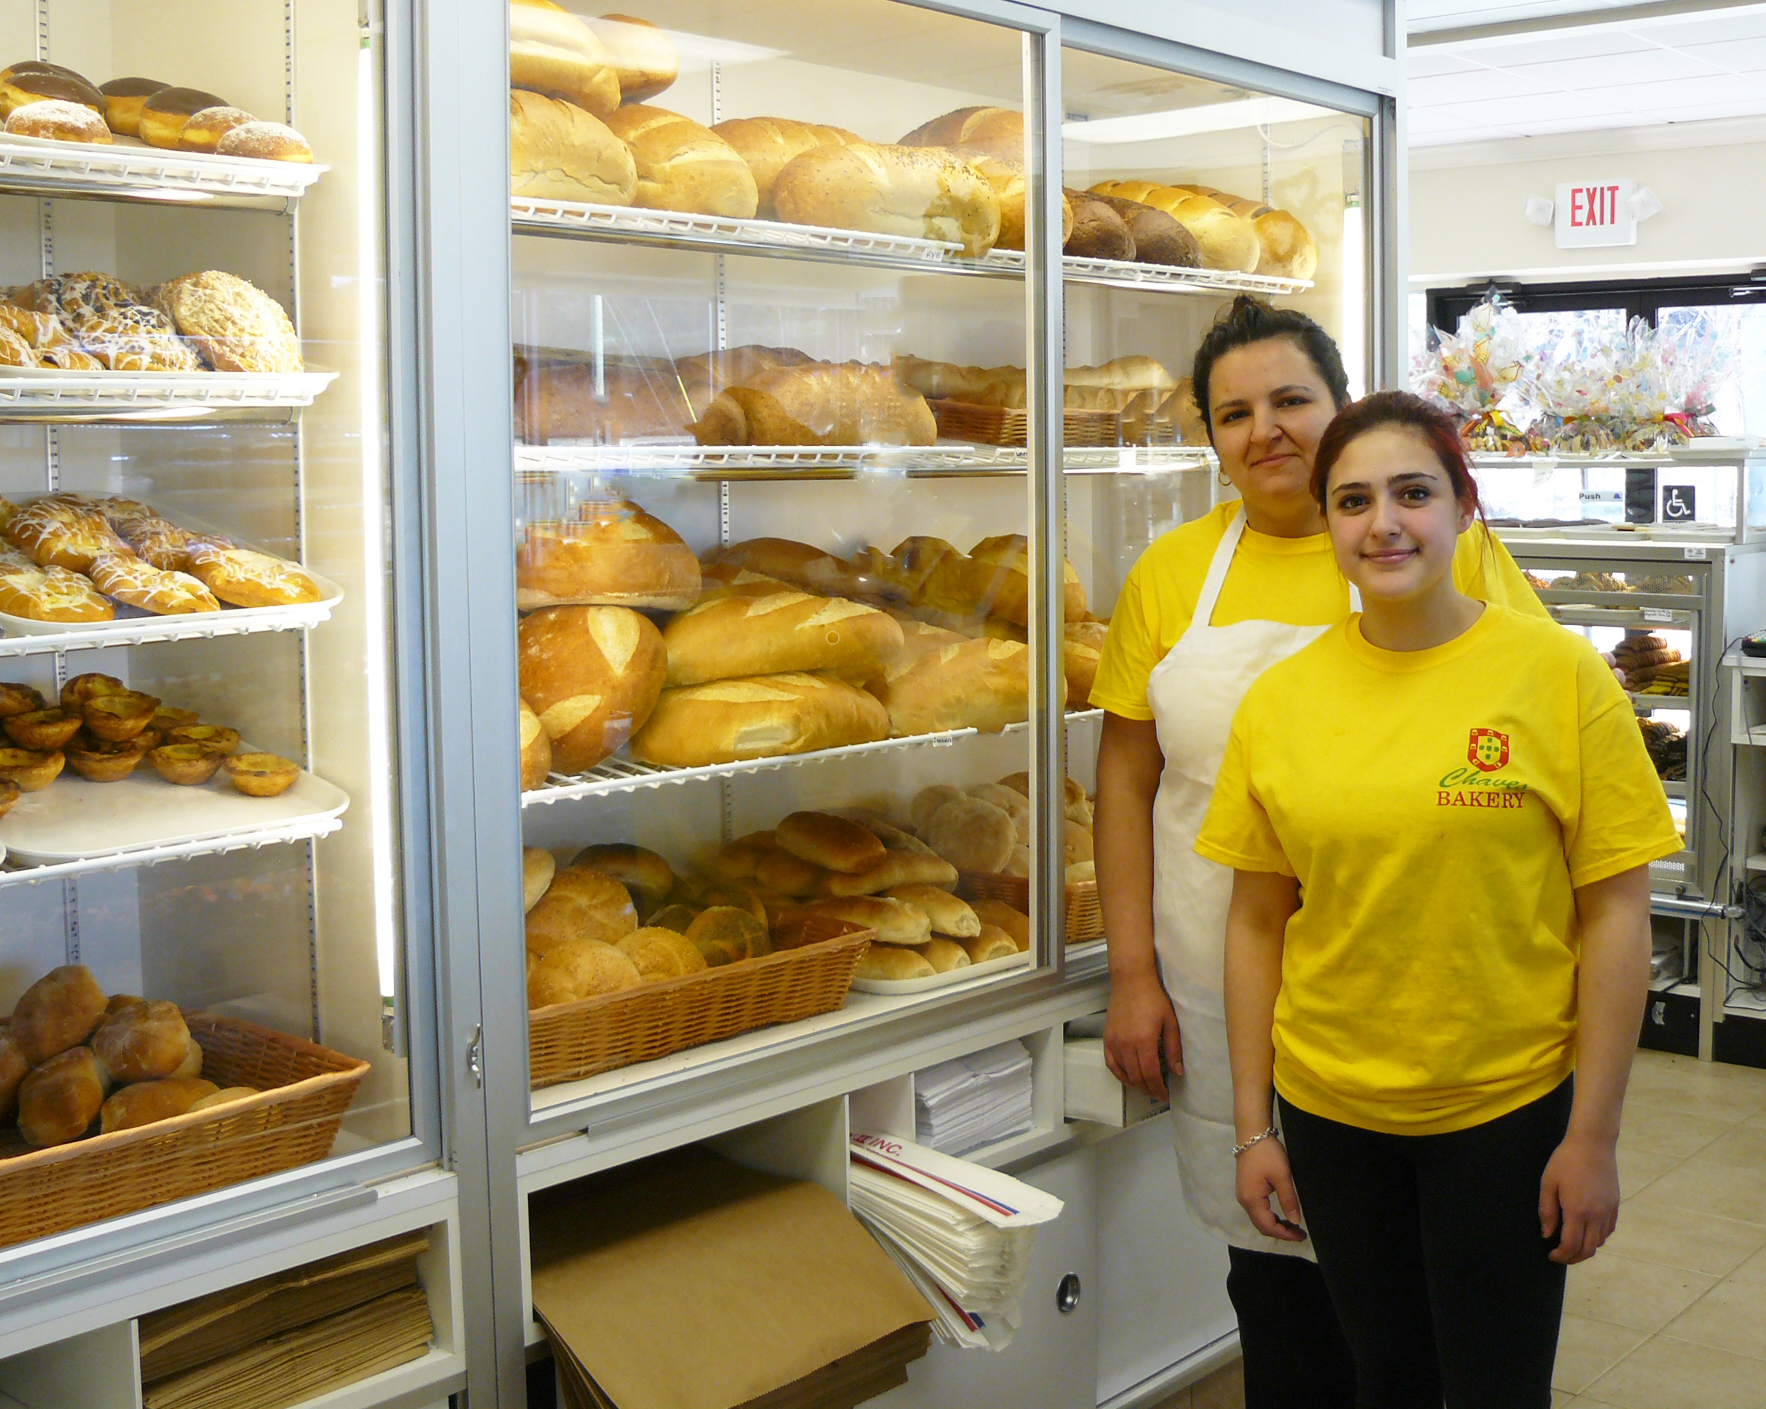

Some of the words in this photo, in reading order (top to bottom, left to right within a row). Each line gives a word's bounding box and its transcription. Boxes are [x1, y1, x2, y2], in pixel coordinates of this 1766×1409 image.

[1570, 185, 1619, 227] EXIT
[1579, 492, 1601, 500] Push
[1439, 768, 1528, 790] Chaves
[1437, 791, 1526, 809] BAKERY
[868, 1138, 903, 1156] INC.
